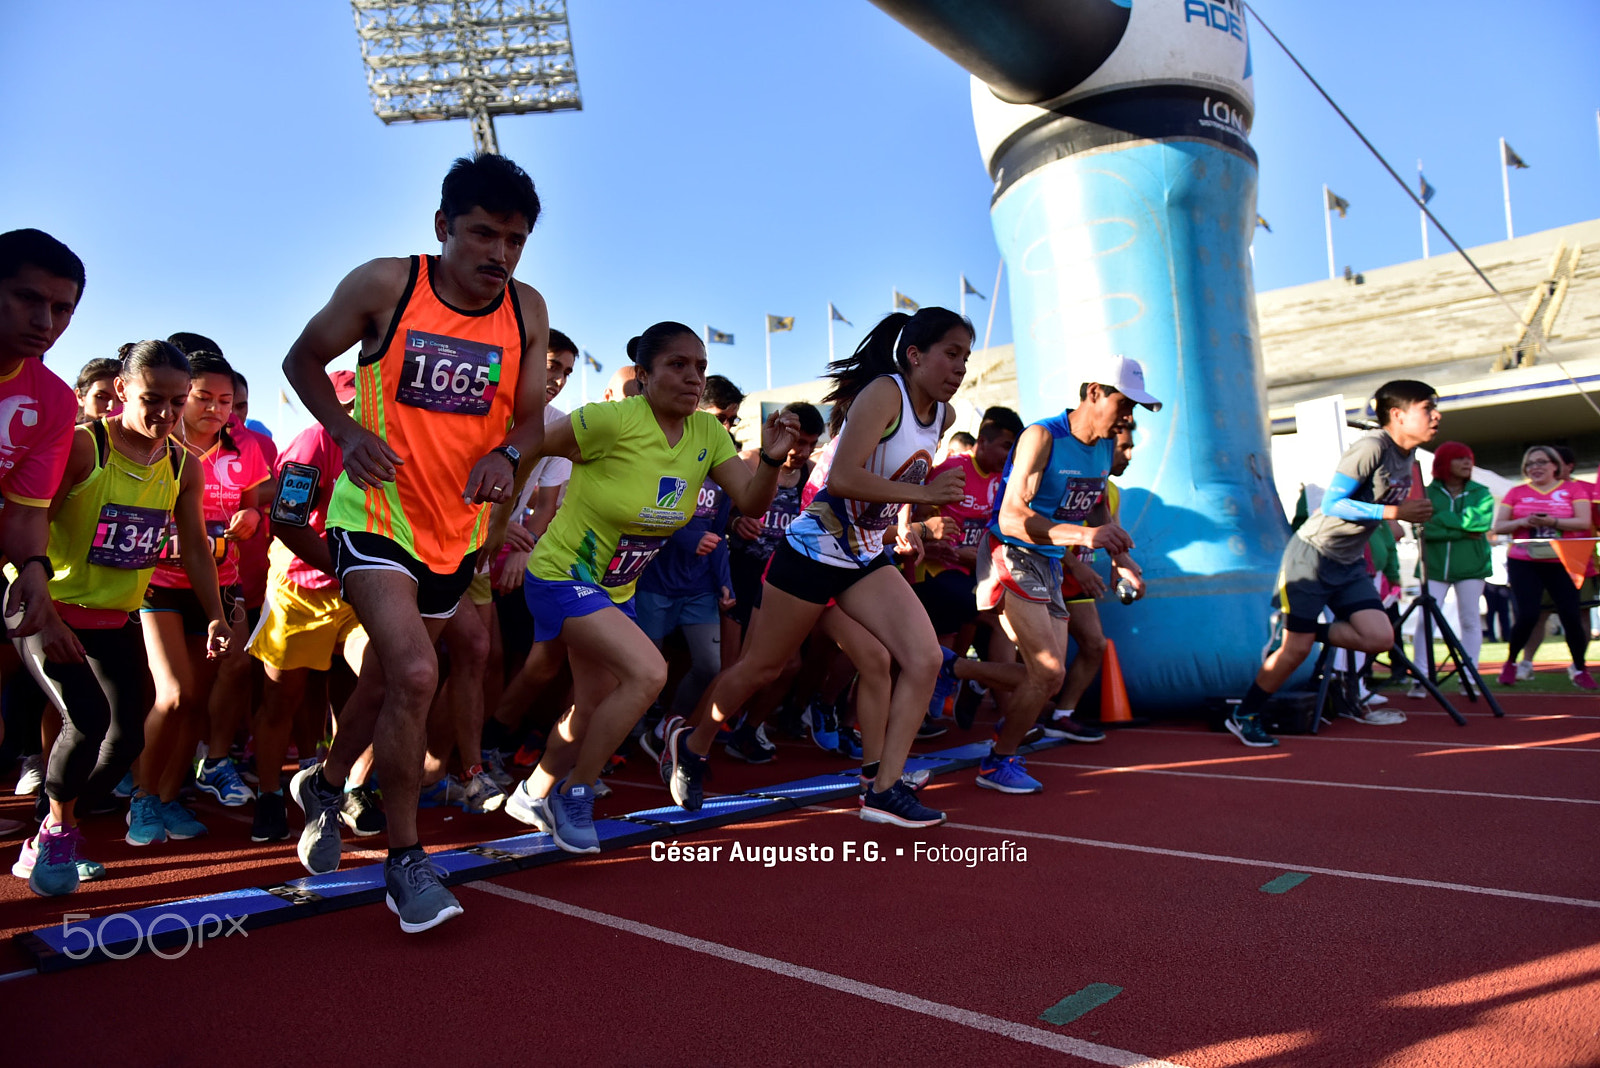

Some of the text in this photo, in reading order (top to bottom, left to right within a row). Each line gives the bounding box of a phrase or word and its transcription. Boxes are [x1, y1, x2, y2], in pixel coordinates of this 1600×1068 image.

[410, 355, 490, 397] 1665
[286, 479, 309, 490] 0.00
[1063, 490, 1102, 511] 1967
[962, 528, 984, 545] 150
